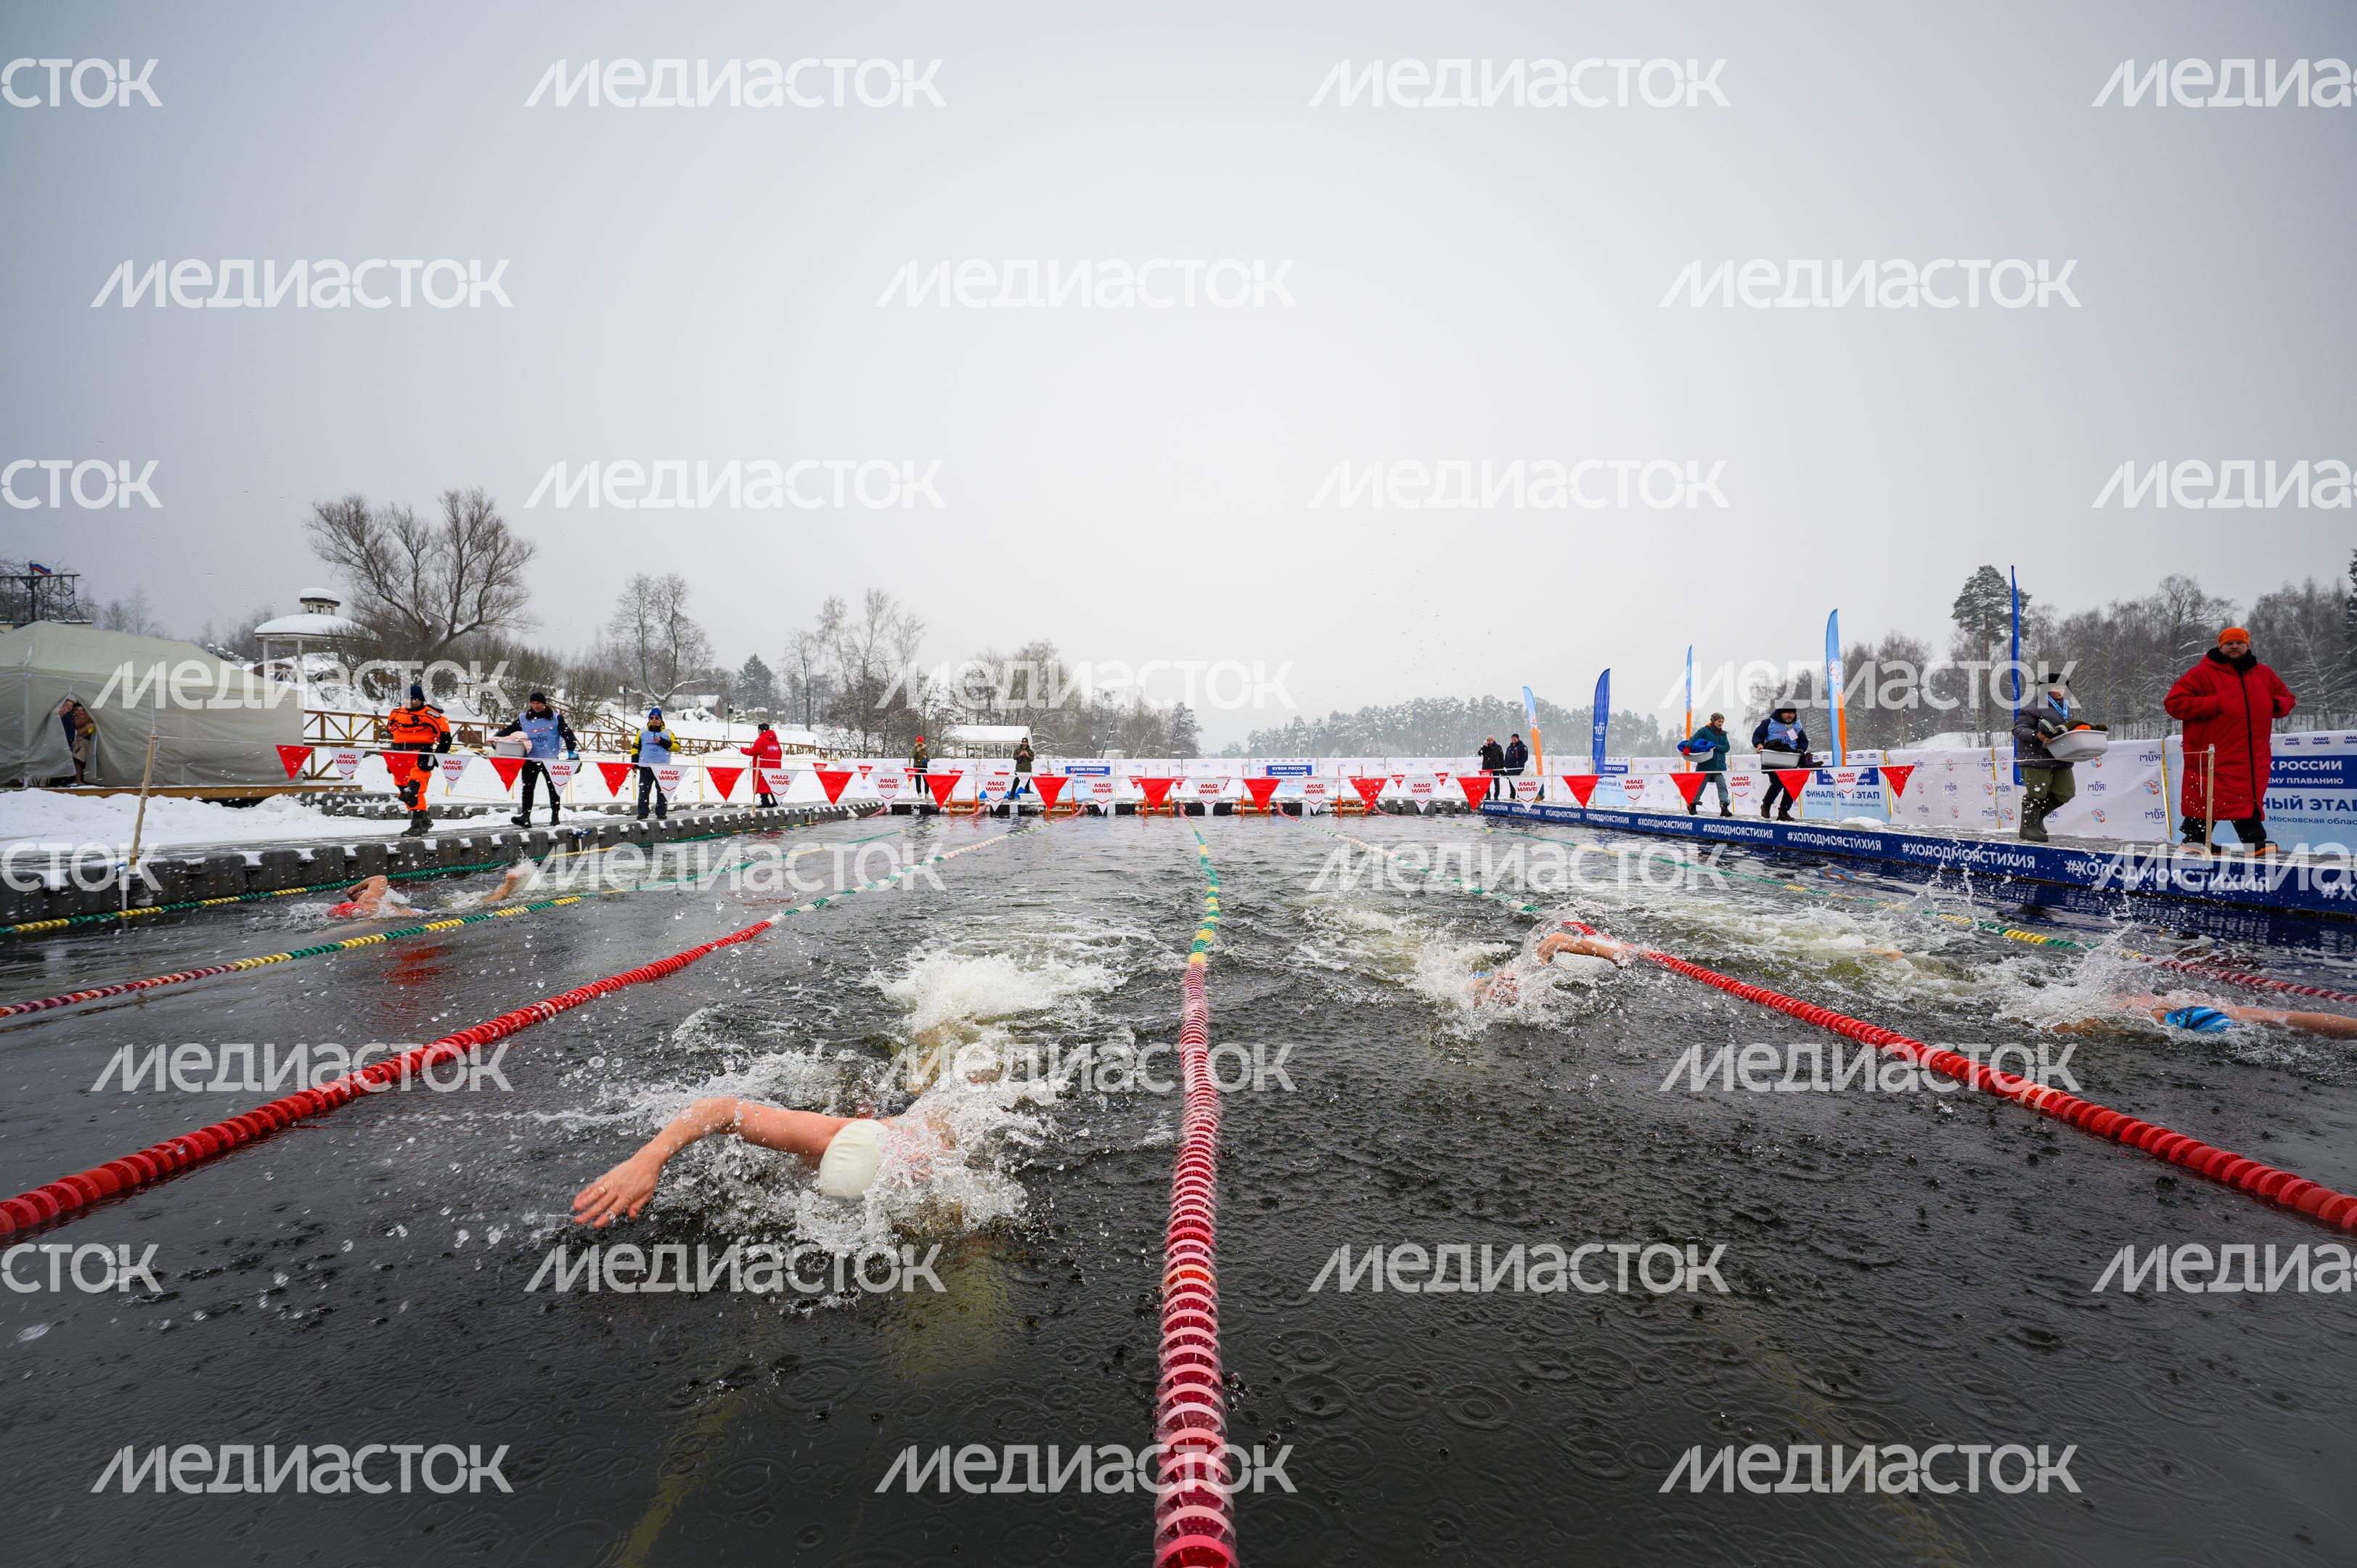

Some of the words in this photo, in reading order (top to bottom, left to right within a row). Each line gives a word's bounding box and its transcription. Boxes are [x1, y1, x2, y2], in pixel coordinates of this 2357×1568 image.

[2279, 761, 2342, 770] РОССИИ
[1806, 790, 1855, 799] ФИНАЛЬН
[1545, 809, 1581, 820] #ХОЛОДМОЯСТИХИЯ
[1586, 812, 1630, 825] #ХОЛОДМОЯСТИХИЯ
[2268, 815, 2325, 824] Московская
[1638, 817, 1693, 830] #ХОЛОДМОЯСТИХИЯ
[1703, 823, 1774, 839] #ХОЛОДМОЯСТИХИЯ
[1787, 831, 1882, 851] #ХОЛОДМОЯСТИХИЯ
[1902, 842, 2036, 869] #ХОЛОДМОЯСТИХИЯ
[2066, 858, 2271, 894] #ХОЛОДМОЯСТИХИЯ
